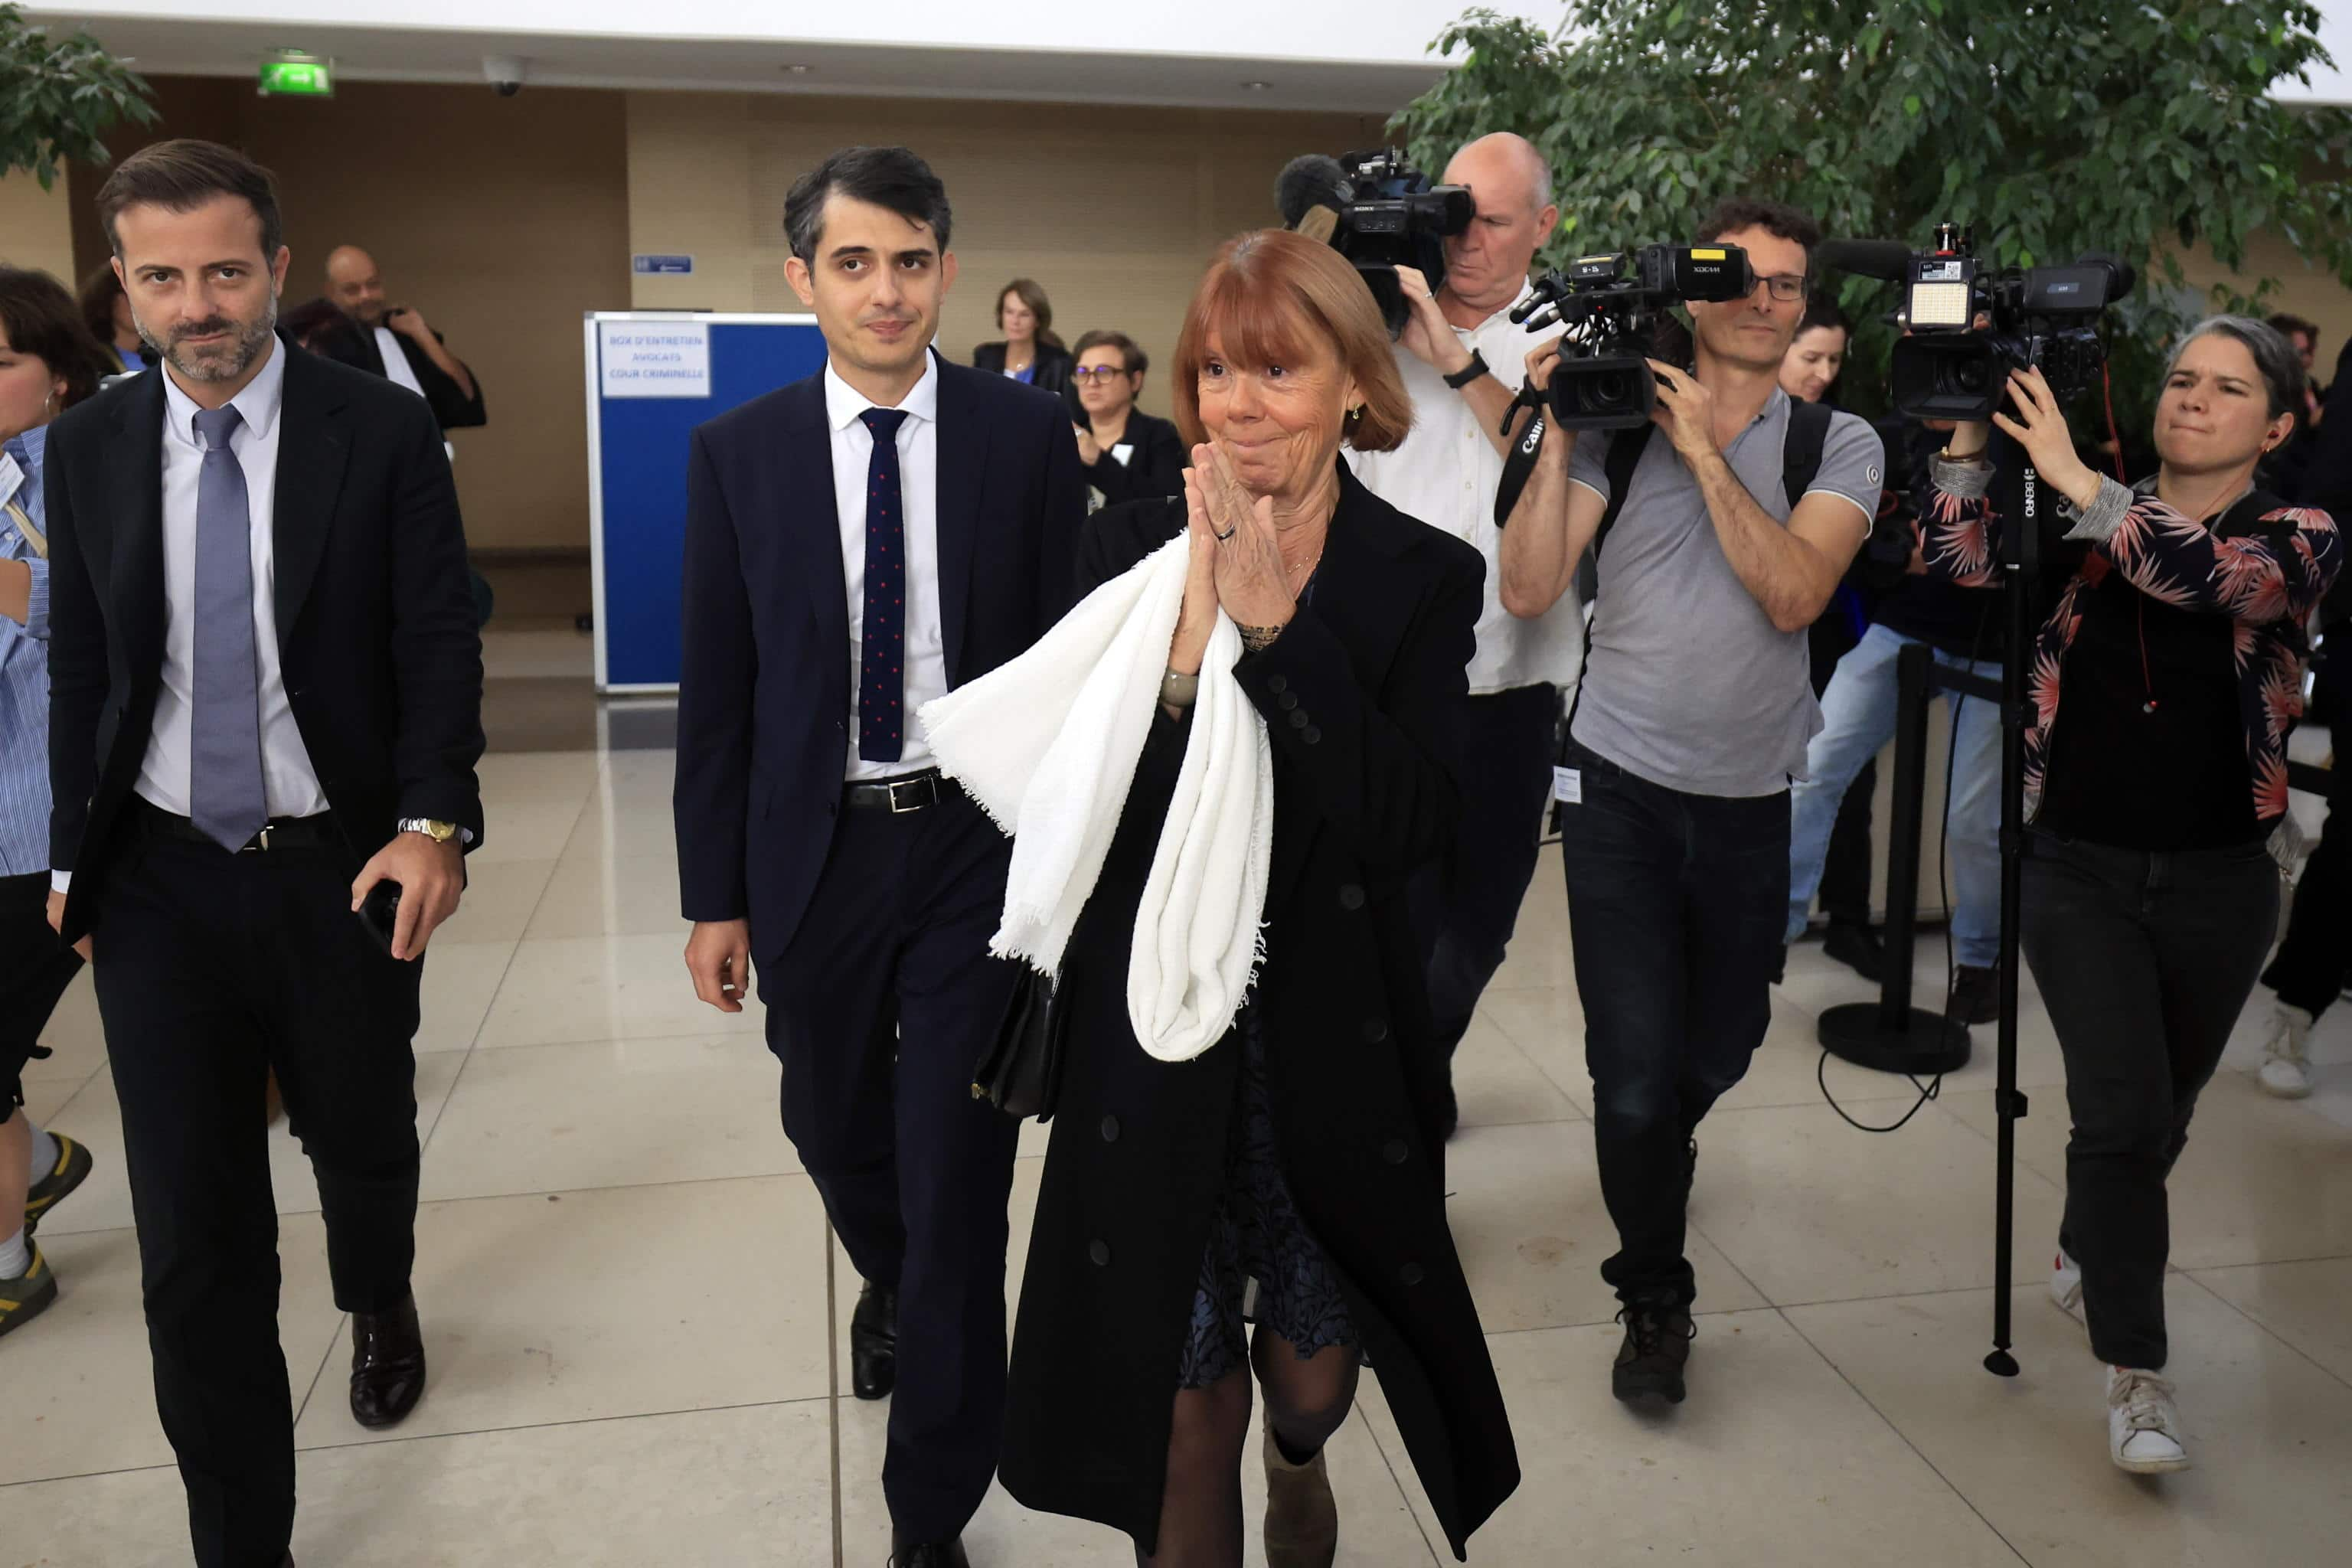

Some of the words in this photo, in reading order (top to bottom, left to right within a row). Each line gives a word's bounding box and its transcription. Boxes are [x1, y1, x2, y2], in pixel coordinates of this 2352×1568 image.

[609, 336, 632, 345] BOX
[632, 352, 681, 362] AVOCATS
[609, 369, 639, 379] COUR
[642, 369, 704, 379] CRIMINELLE
[1522, 418, 1544, 454] Cano
[2024, 482, 2035, 518] BENRO
